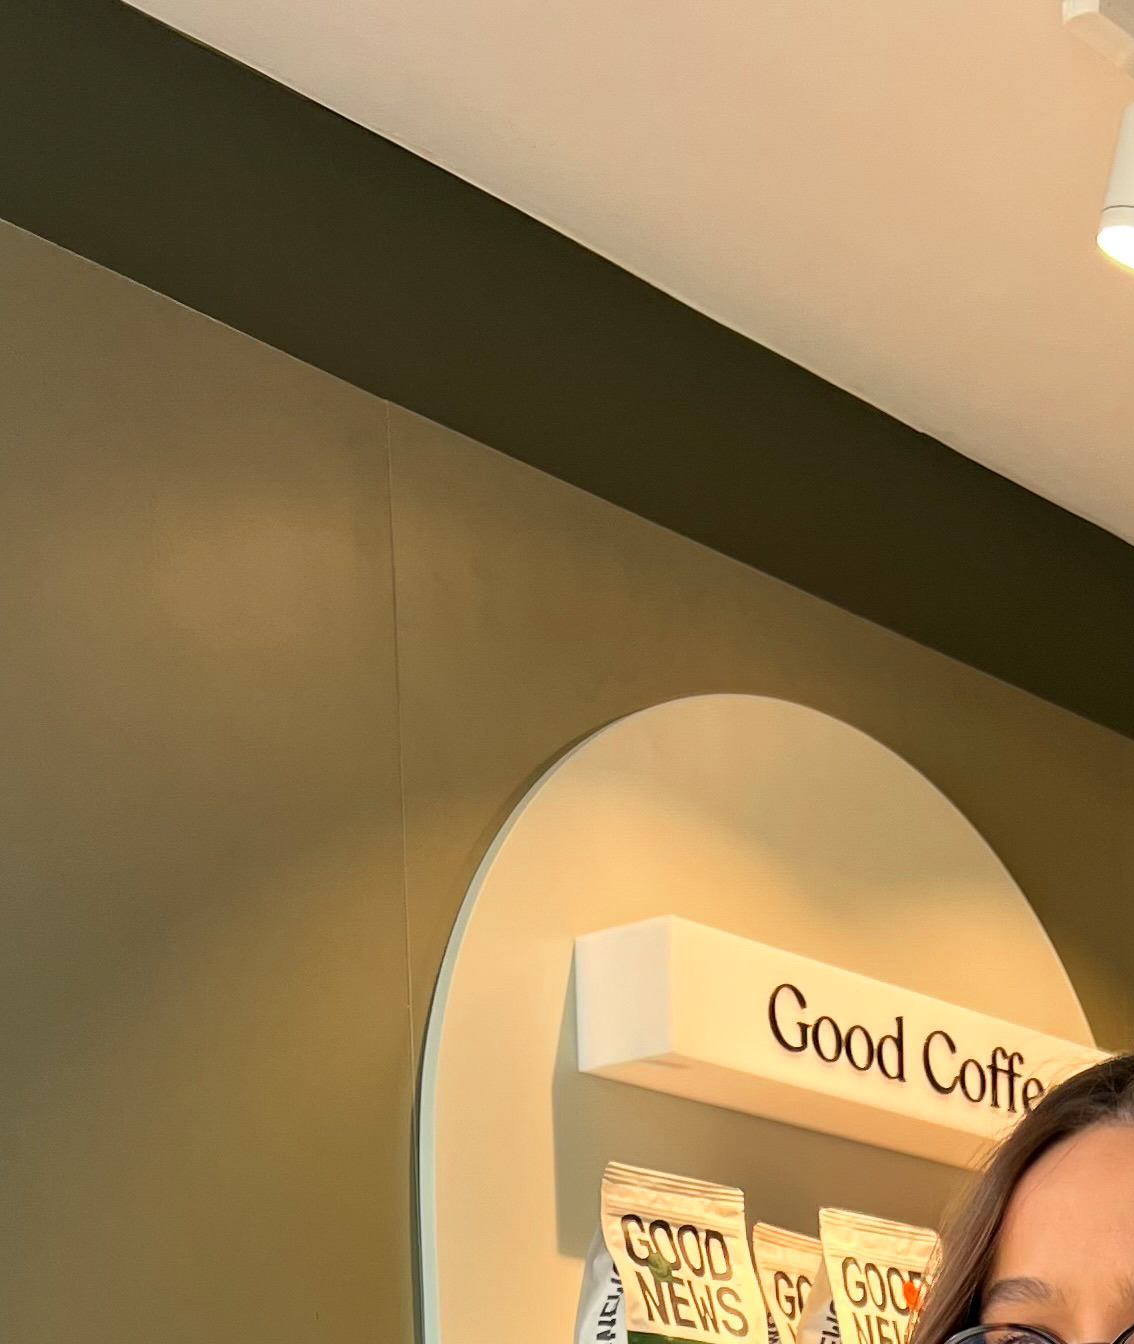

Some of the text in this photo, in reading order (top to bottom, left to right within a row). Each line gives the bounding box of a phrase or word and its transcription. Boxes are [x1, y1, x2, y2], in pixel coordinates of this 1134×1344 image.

[768, 983, 1046, 1113] Good Coffe
[621, 1214, 733, 1281] GOOD
[635, 1271, 749, 1337] NEWS
